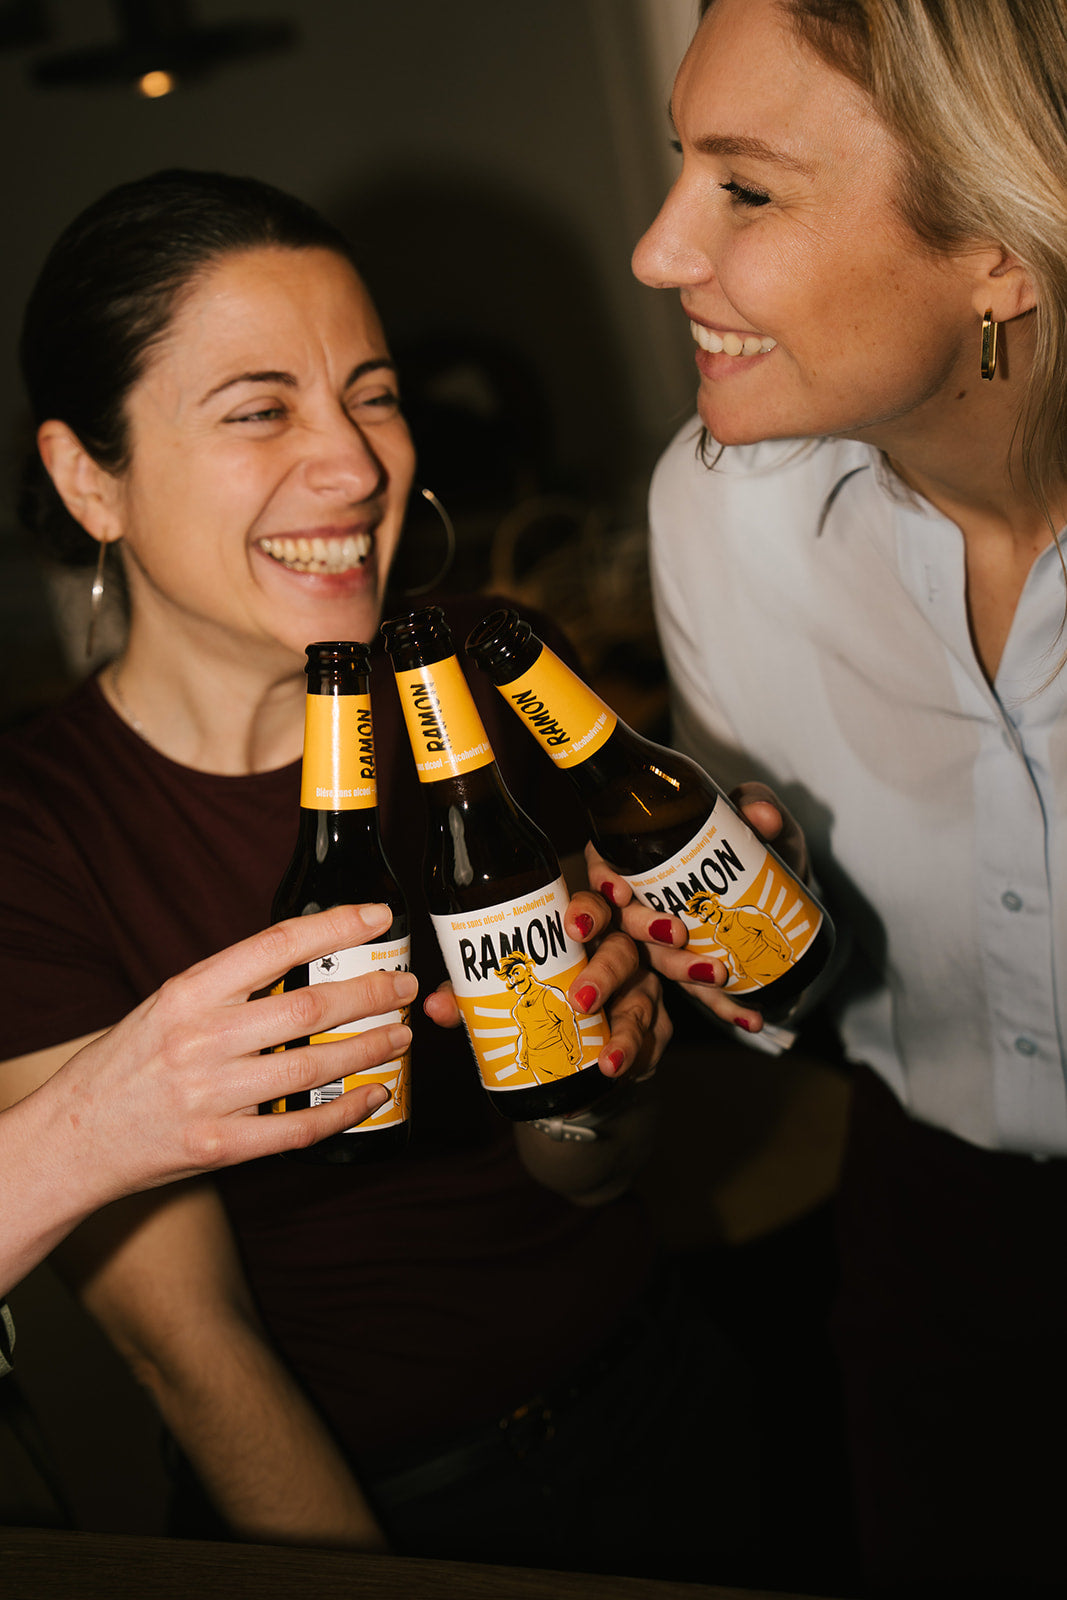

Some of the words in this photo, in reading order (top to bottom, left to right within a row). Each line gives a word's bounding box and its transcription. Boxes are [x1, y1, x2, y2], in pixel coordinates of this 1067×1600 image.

[512, 689, 571, 746] RAMON
[356, 708, 376, 780] RAMON
[451, 743, 484, 764] lcoholvrij
[334, 788, 352, 798] ans
[643, 839, 746, 921] RAMON
[466, 918, 483, 929] sans
[483, 912, 506, 926] alcool
[512, 899, 546, 917] Alcoholvrij
[371, 951, 387, 961] Bière
[459, 909, 567, 982] RAMON
